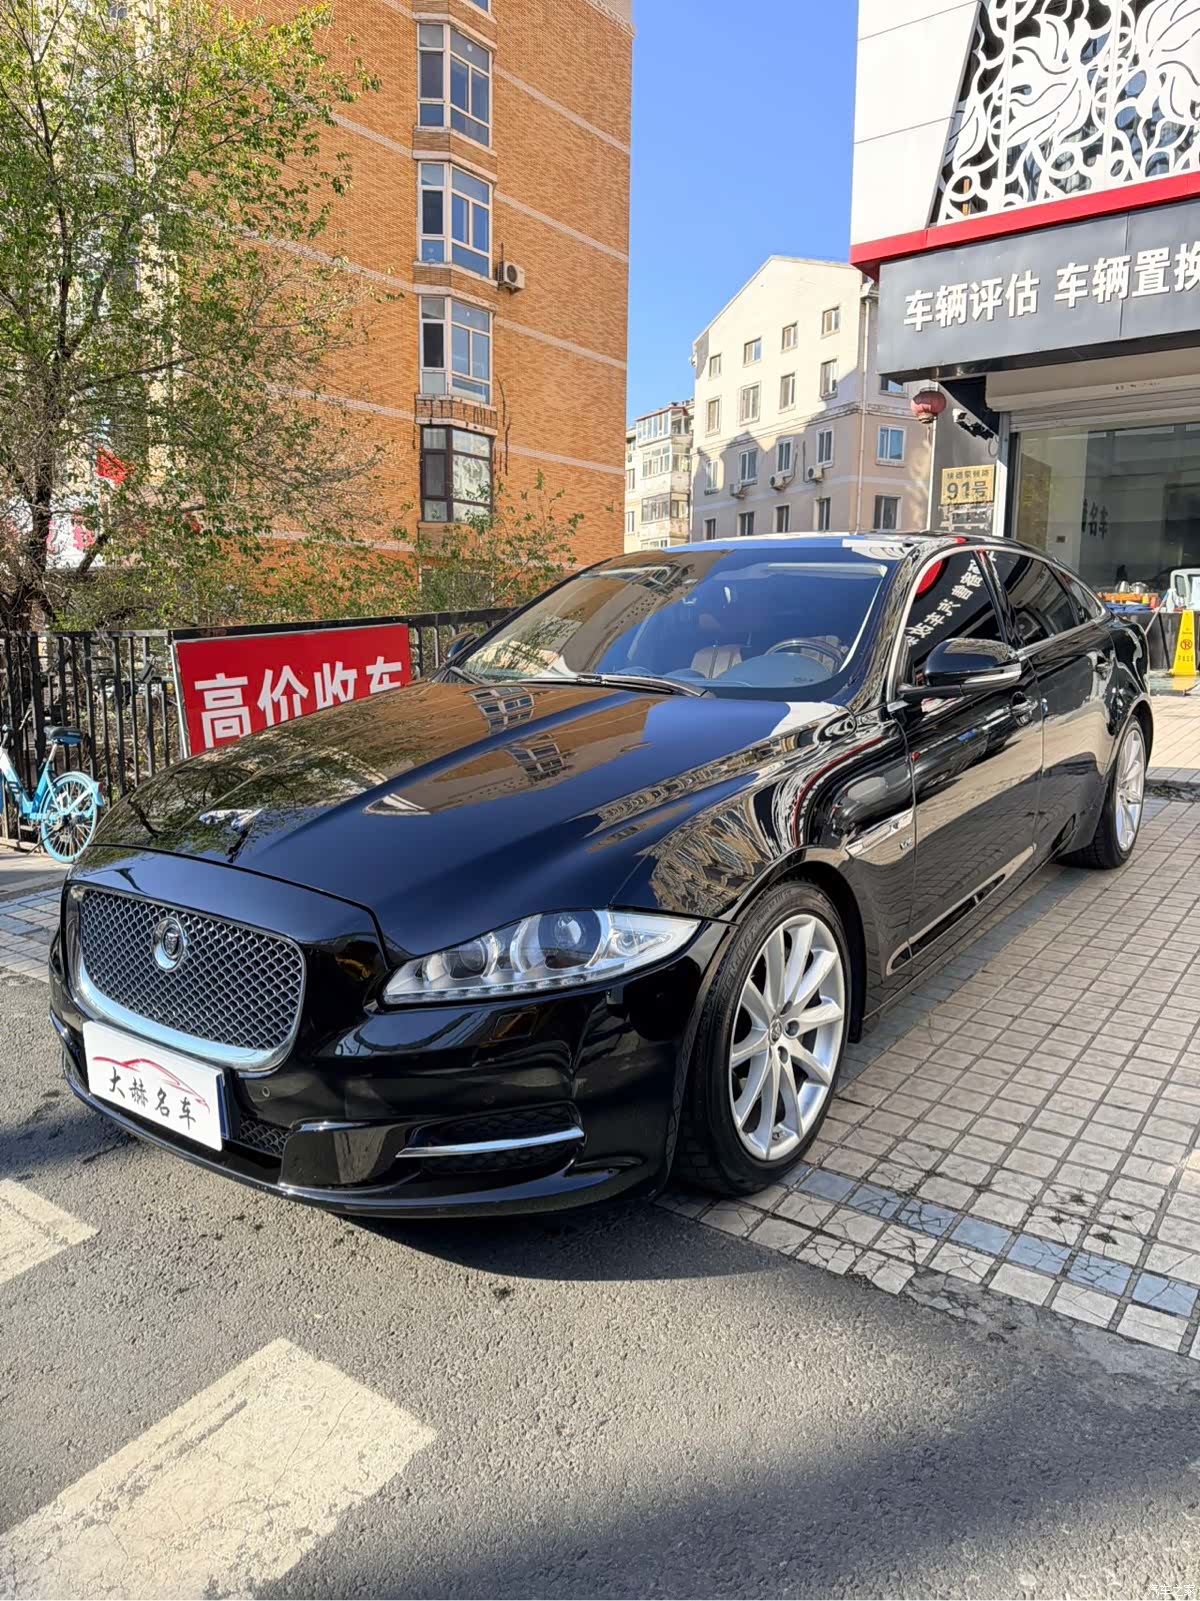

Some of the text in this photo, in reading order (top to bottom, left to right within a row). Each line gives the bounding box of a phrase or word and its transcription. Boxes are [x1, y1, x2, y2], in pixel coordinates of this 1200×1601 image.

[903, 271, 1040, 331] 车辆评估
[946, 480, 989, 500] 91号
[106, 1066, 197, 1131] 大赫名车
